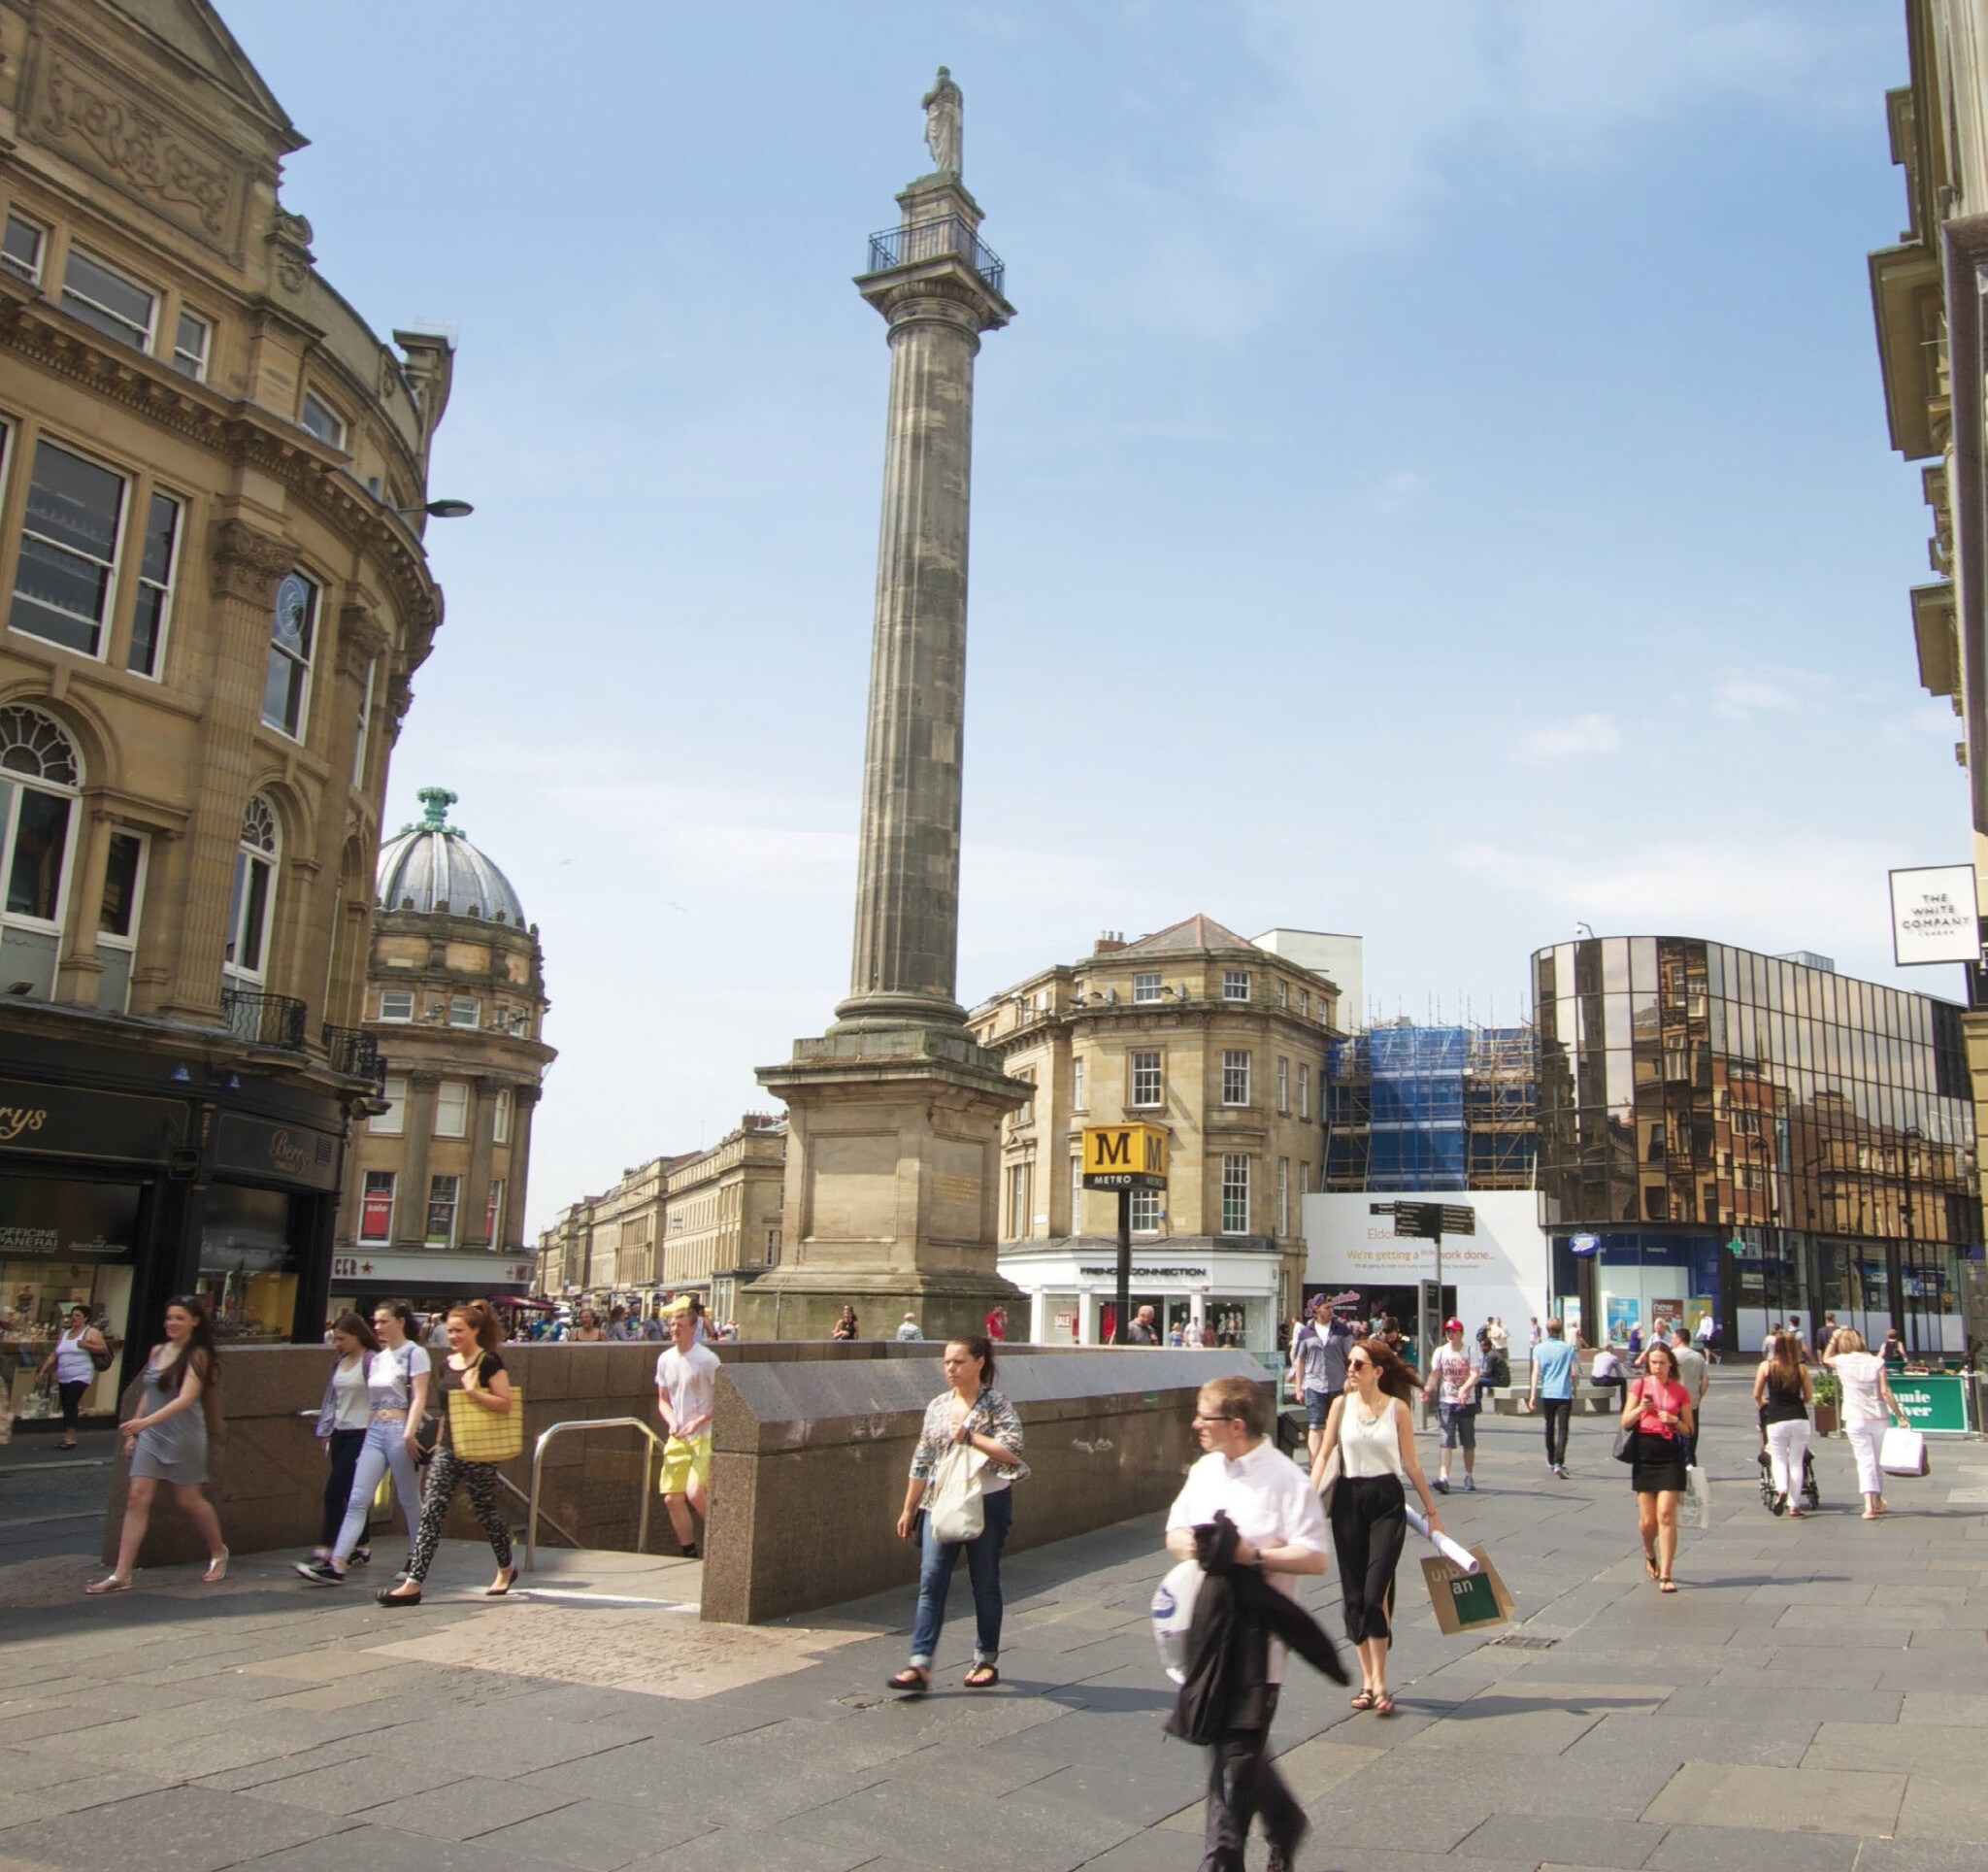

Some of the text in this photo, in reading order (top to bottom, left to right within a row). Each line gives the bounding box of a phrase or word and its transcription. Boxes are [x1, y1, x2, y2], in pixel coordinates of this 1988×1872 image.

[1922, 893, 1948, 903] THE
[1910, 904, 1955, 915] WHITE
[1903, 916, 1971, 929] COMPANY
[1095, 1132, 1131, 1165] M
[1146, 1135, 1162, 1172] M
[1093, 1175, 1132, 1185] METRO
[366, 1202, 388, 1213] sale
[1375, 1249, 1411, 1262] getting
[1129, 1268, 1207, 1277] CONNECTION
[1653, 1303, 1674, 1312] new
[1452, 1580, 1474, 1595] an
